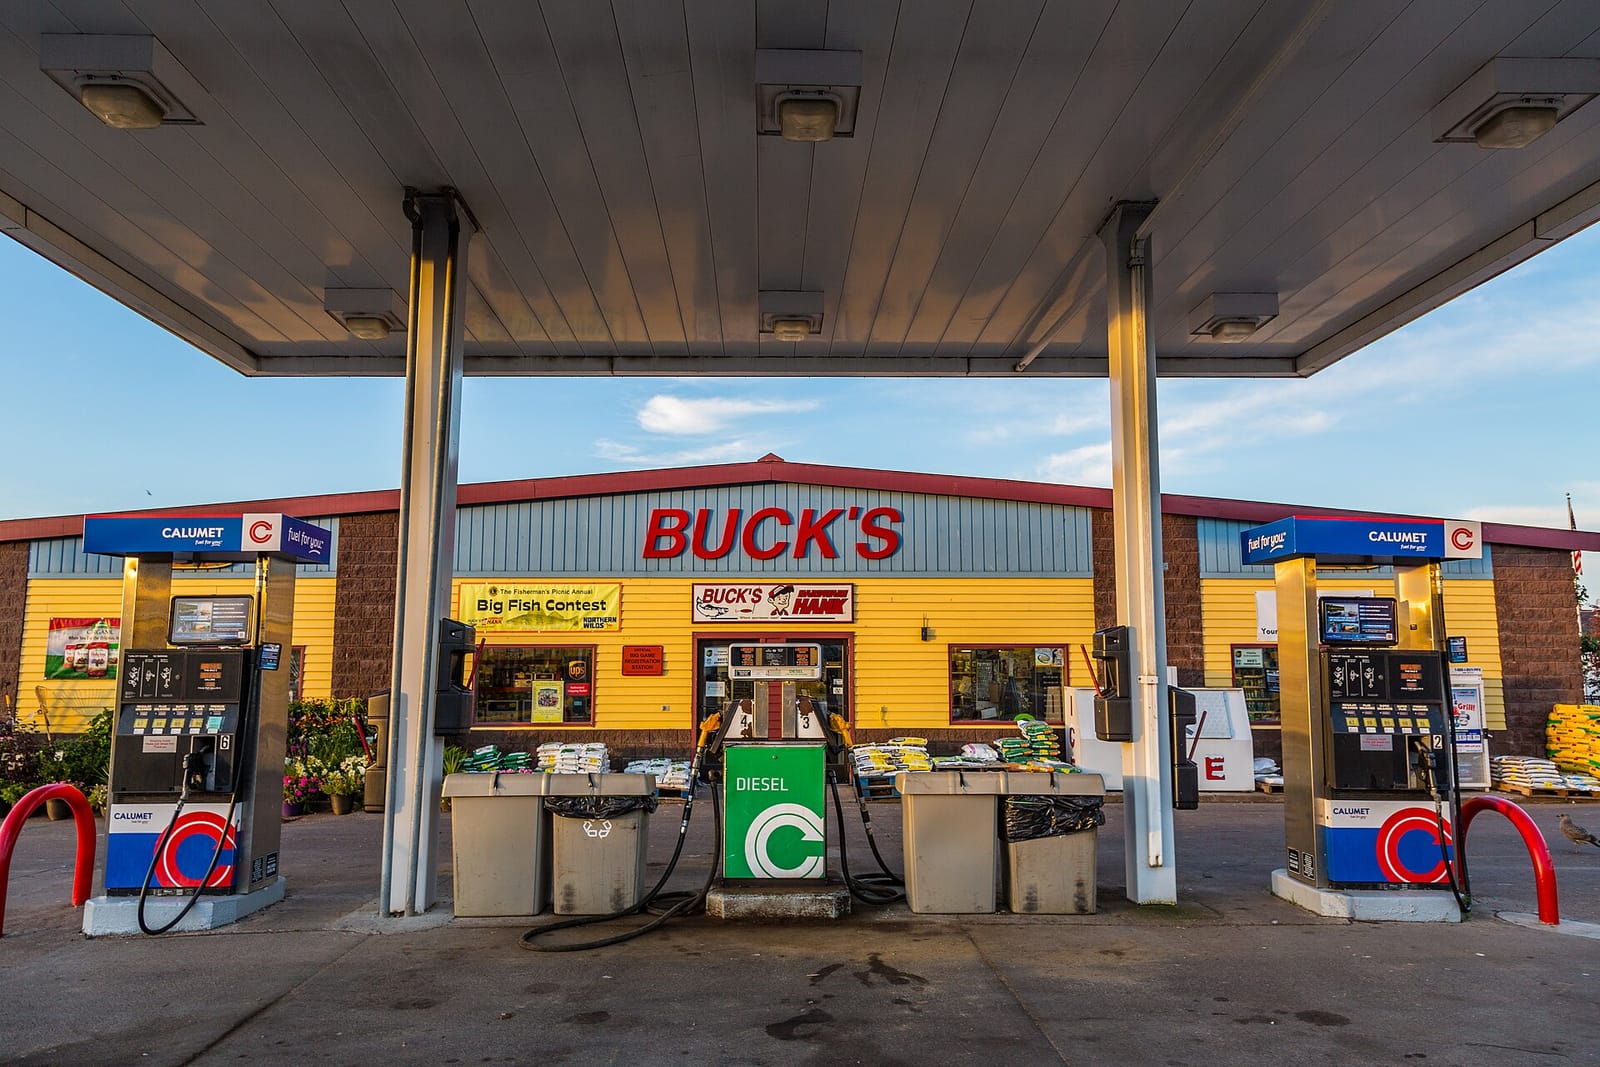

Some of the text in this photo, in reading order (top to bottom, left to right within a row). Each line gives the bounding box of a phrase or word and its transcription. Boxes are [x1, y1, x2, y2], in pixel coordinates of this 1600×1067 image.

[162, 527, 224, 538] CALUMET
[287, 527, 301, 542] fuel
[301, 531, 310, 546] for
[642, 506, 904, 560] BUCK'S
[1368, 531, 1428, 543] CALUMET
[1248, 536, 1261, 553] fuel
[1260, 534, 1271, 550] for
[702, 587, 763, 604] BUCK'S
[477, 599, 607, 614] Big Fish Contest
[791, 598, 849, 615] HANK
[740, 715, 748, 727] 4
[802, 716, 810, 729] 3
[221, 735, 229, 748] 6
[1434, 735, 1442, 748] 2
[736, 777, 789, 791] DIESEL
[113, 812, 153, 820] CALUMET
[1332, 807, 1370, 815] CALUMET
